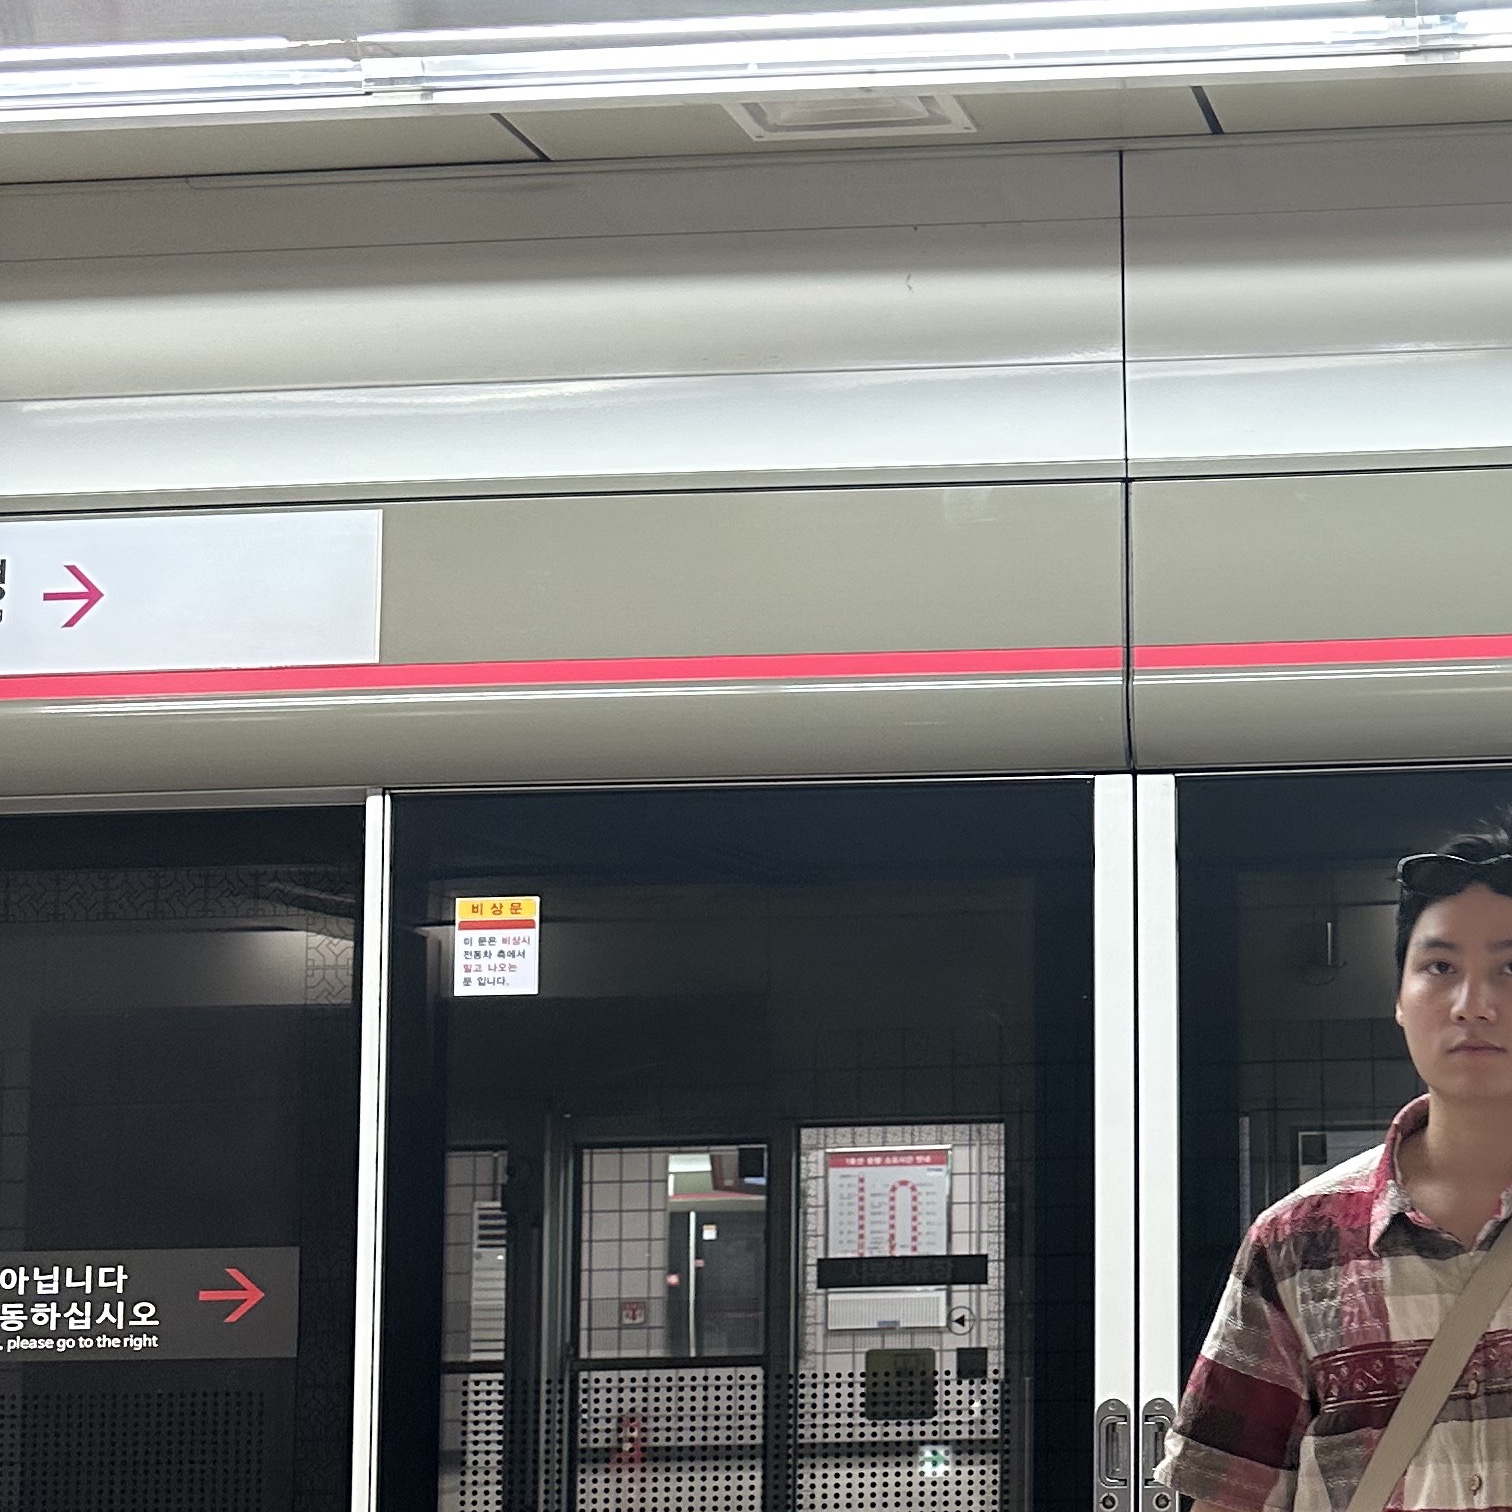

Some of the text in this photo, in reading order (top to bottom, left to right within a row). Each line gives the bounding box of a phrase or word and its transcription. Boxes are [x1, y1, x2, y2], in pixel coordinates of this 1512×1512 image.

[471, 902, 523, 916] 비상문
[0, 1265, 128, 1295] 아닙니다
[0, 1301, 159, 1331] 동하십시오
[7, 1334, 158, 1352] please go to the right
